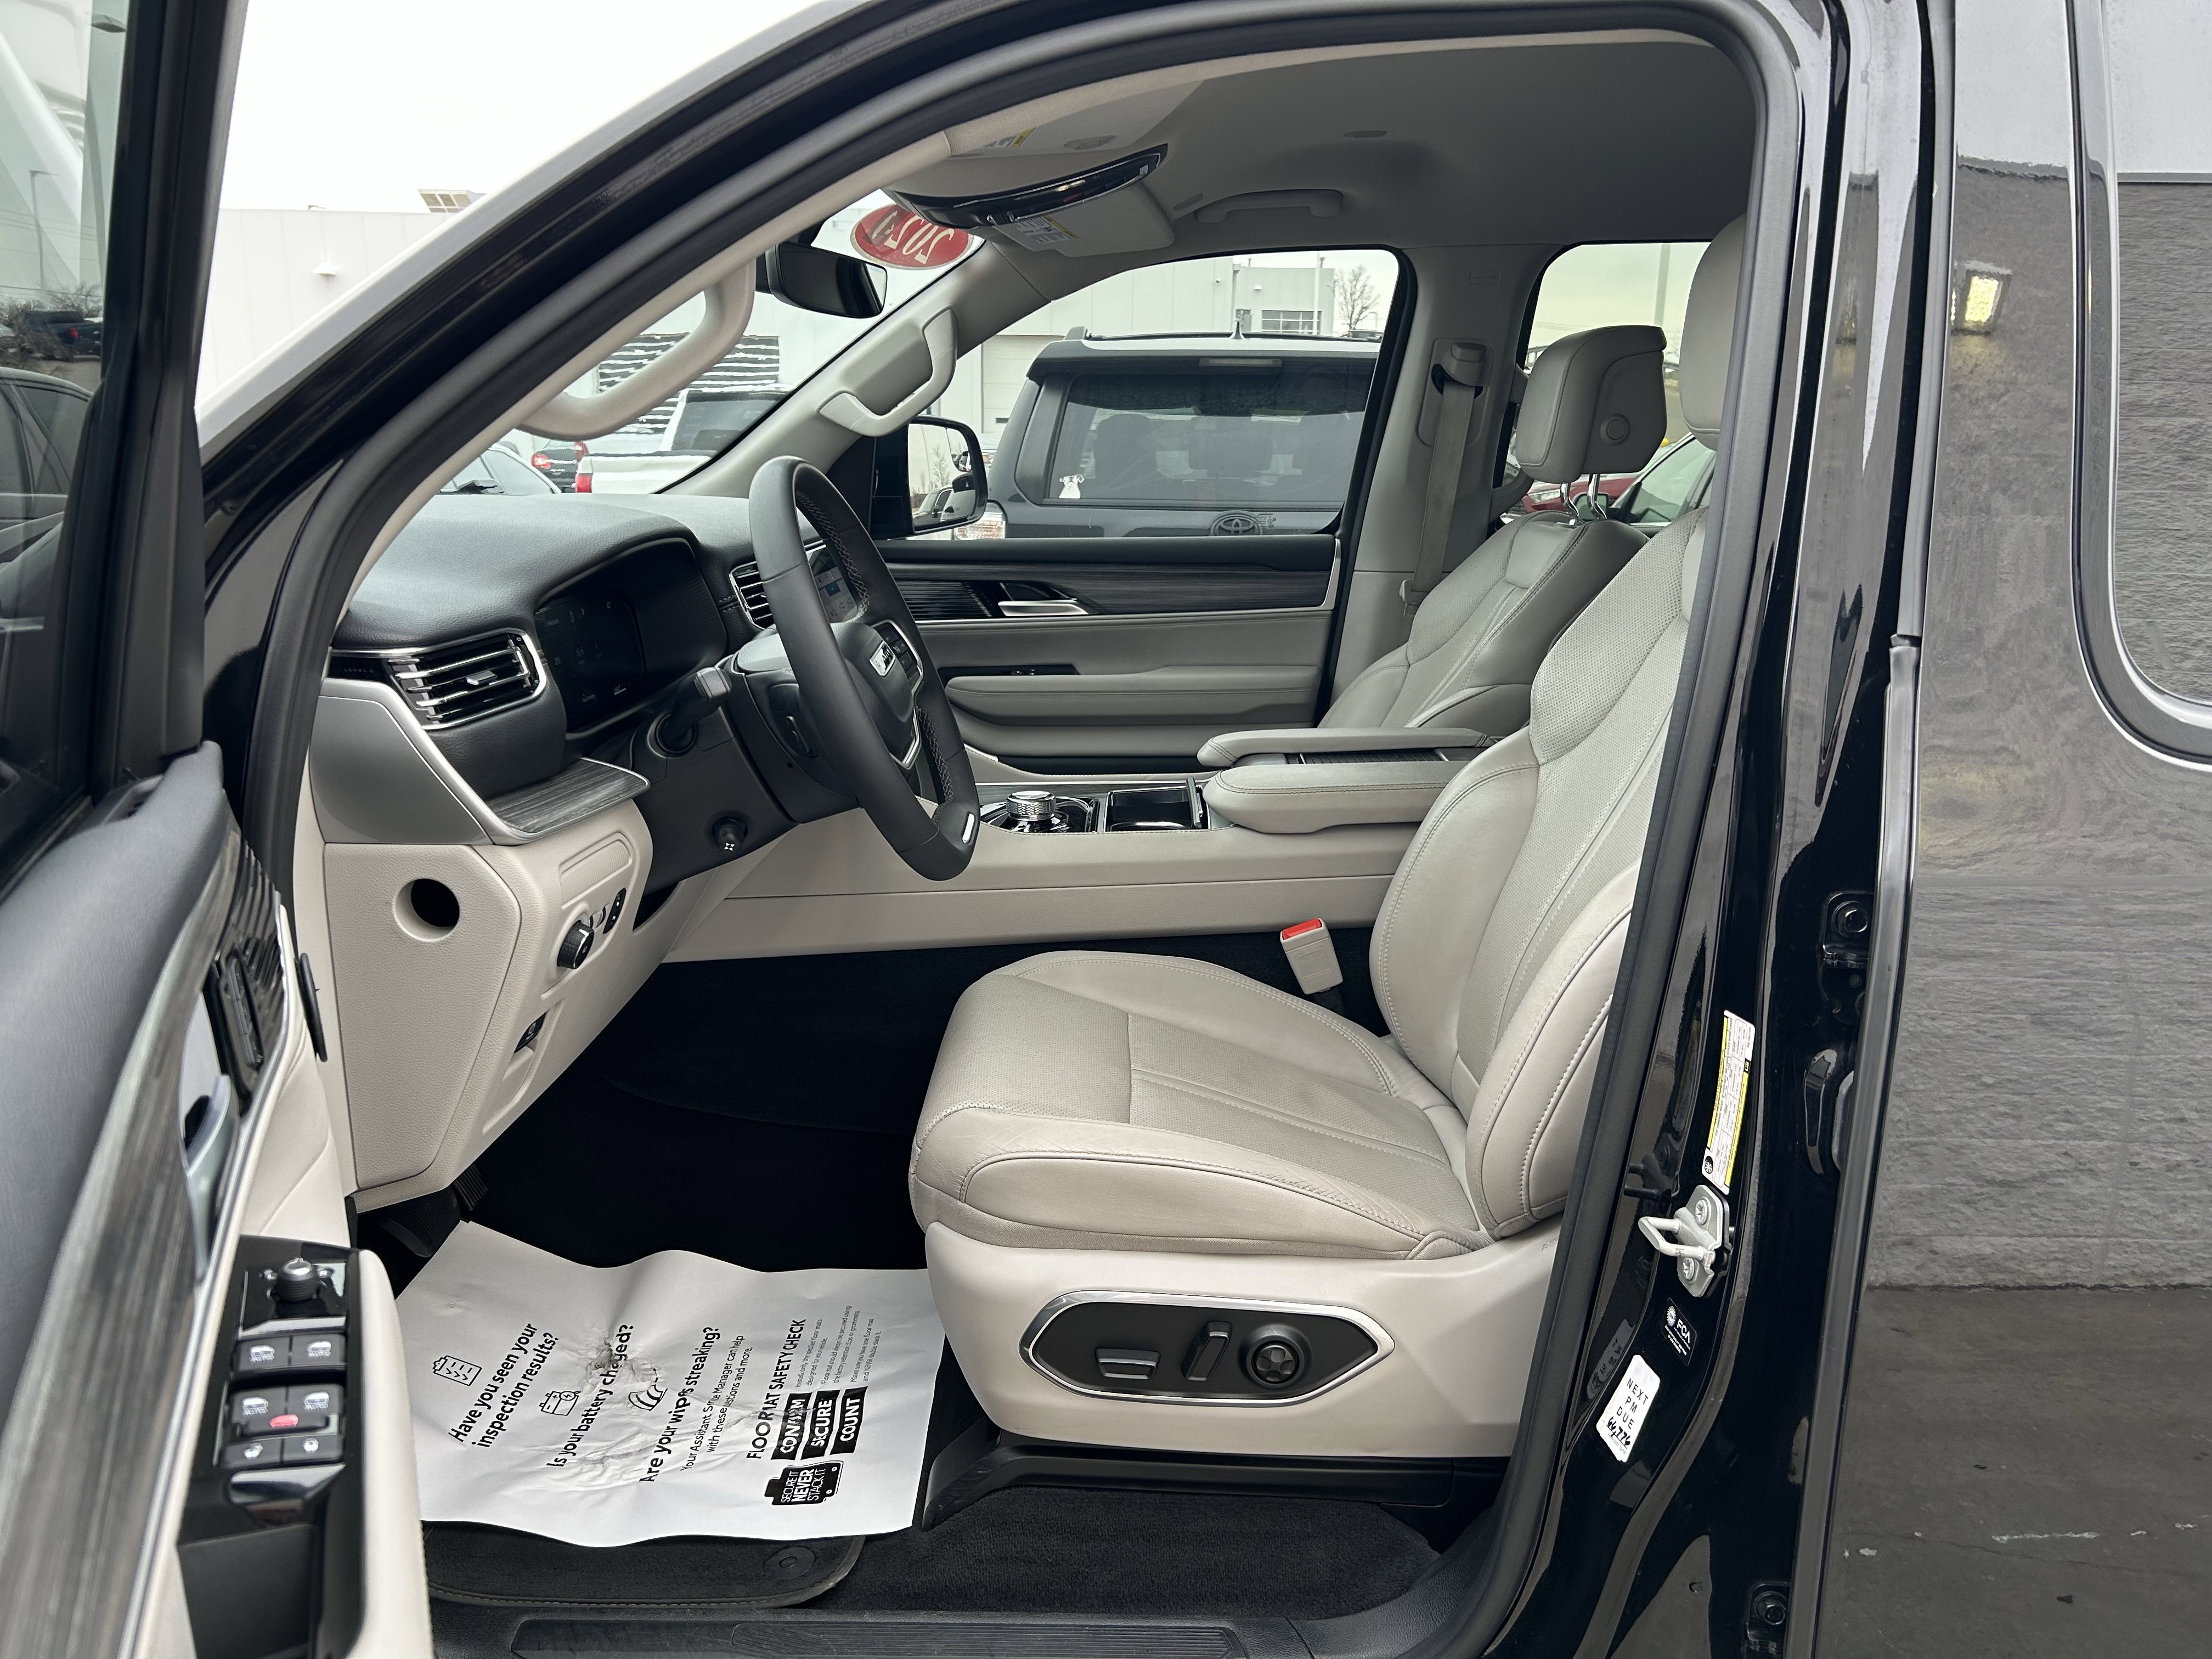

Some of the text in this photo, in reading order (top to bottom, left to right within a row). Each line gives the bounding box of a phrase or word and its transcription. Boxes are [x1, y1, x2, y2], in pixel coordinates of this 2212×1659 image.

[729, 1335, 746, 1349] help
[1677, 1318, 1690, 1344] FCA
[727, 1349, 738, 1361] can
[740, 1347, 753, 1368] more.
[448, 1323, 538, 1442] Have you seen your
[712, 1362, 733, 1394] Manager
[735, 1368, 746, 1381] and
[471, 1332, 559, 1448] inspection results?
[746, 1411, 773, 1459] FLOOR
[768, 1351, 794, 1390] SAFETY
[782, 1318, 806, 1351] CHECK
[1626, 1378, 1649, 1405] NEXT
[570, 1389, 613, 1432] battery
[639, 1457, 664, 1482] Are
[653, 1425, 678, 1455] your
[684, 1327, 721, 1387] streaking?
[1625, 1395, 1638, 1414] PM
[713, 1407, 728, 1434] these
[810, 1398, 833, 1447] SECURE
[839, 1397, 861, 1442] COUNT
[1616, 1406, 1635, 1430] DUE
[558, 1433, 584, 1457] your
[690, 1413, 713, 1452] Assistant
[707, 1434, 720, 1453] with
[546, 1457, 568, 1467] Is
[680, 1453, 698, 1471] Your
[780, 1477, 799, 1502] SECURE
[791, 1469, 815, 1502] NEVER
[806, 1475, 825, 1501] STACK
